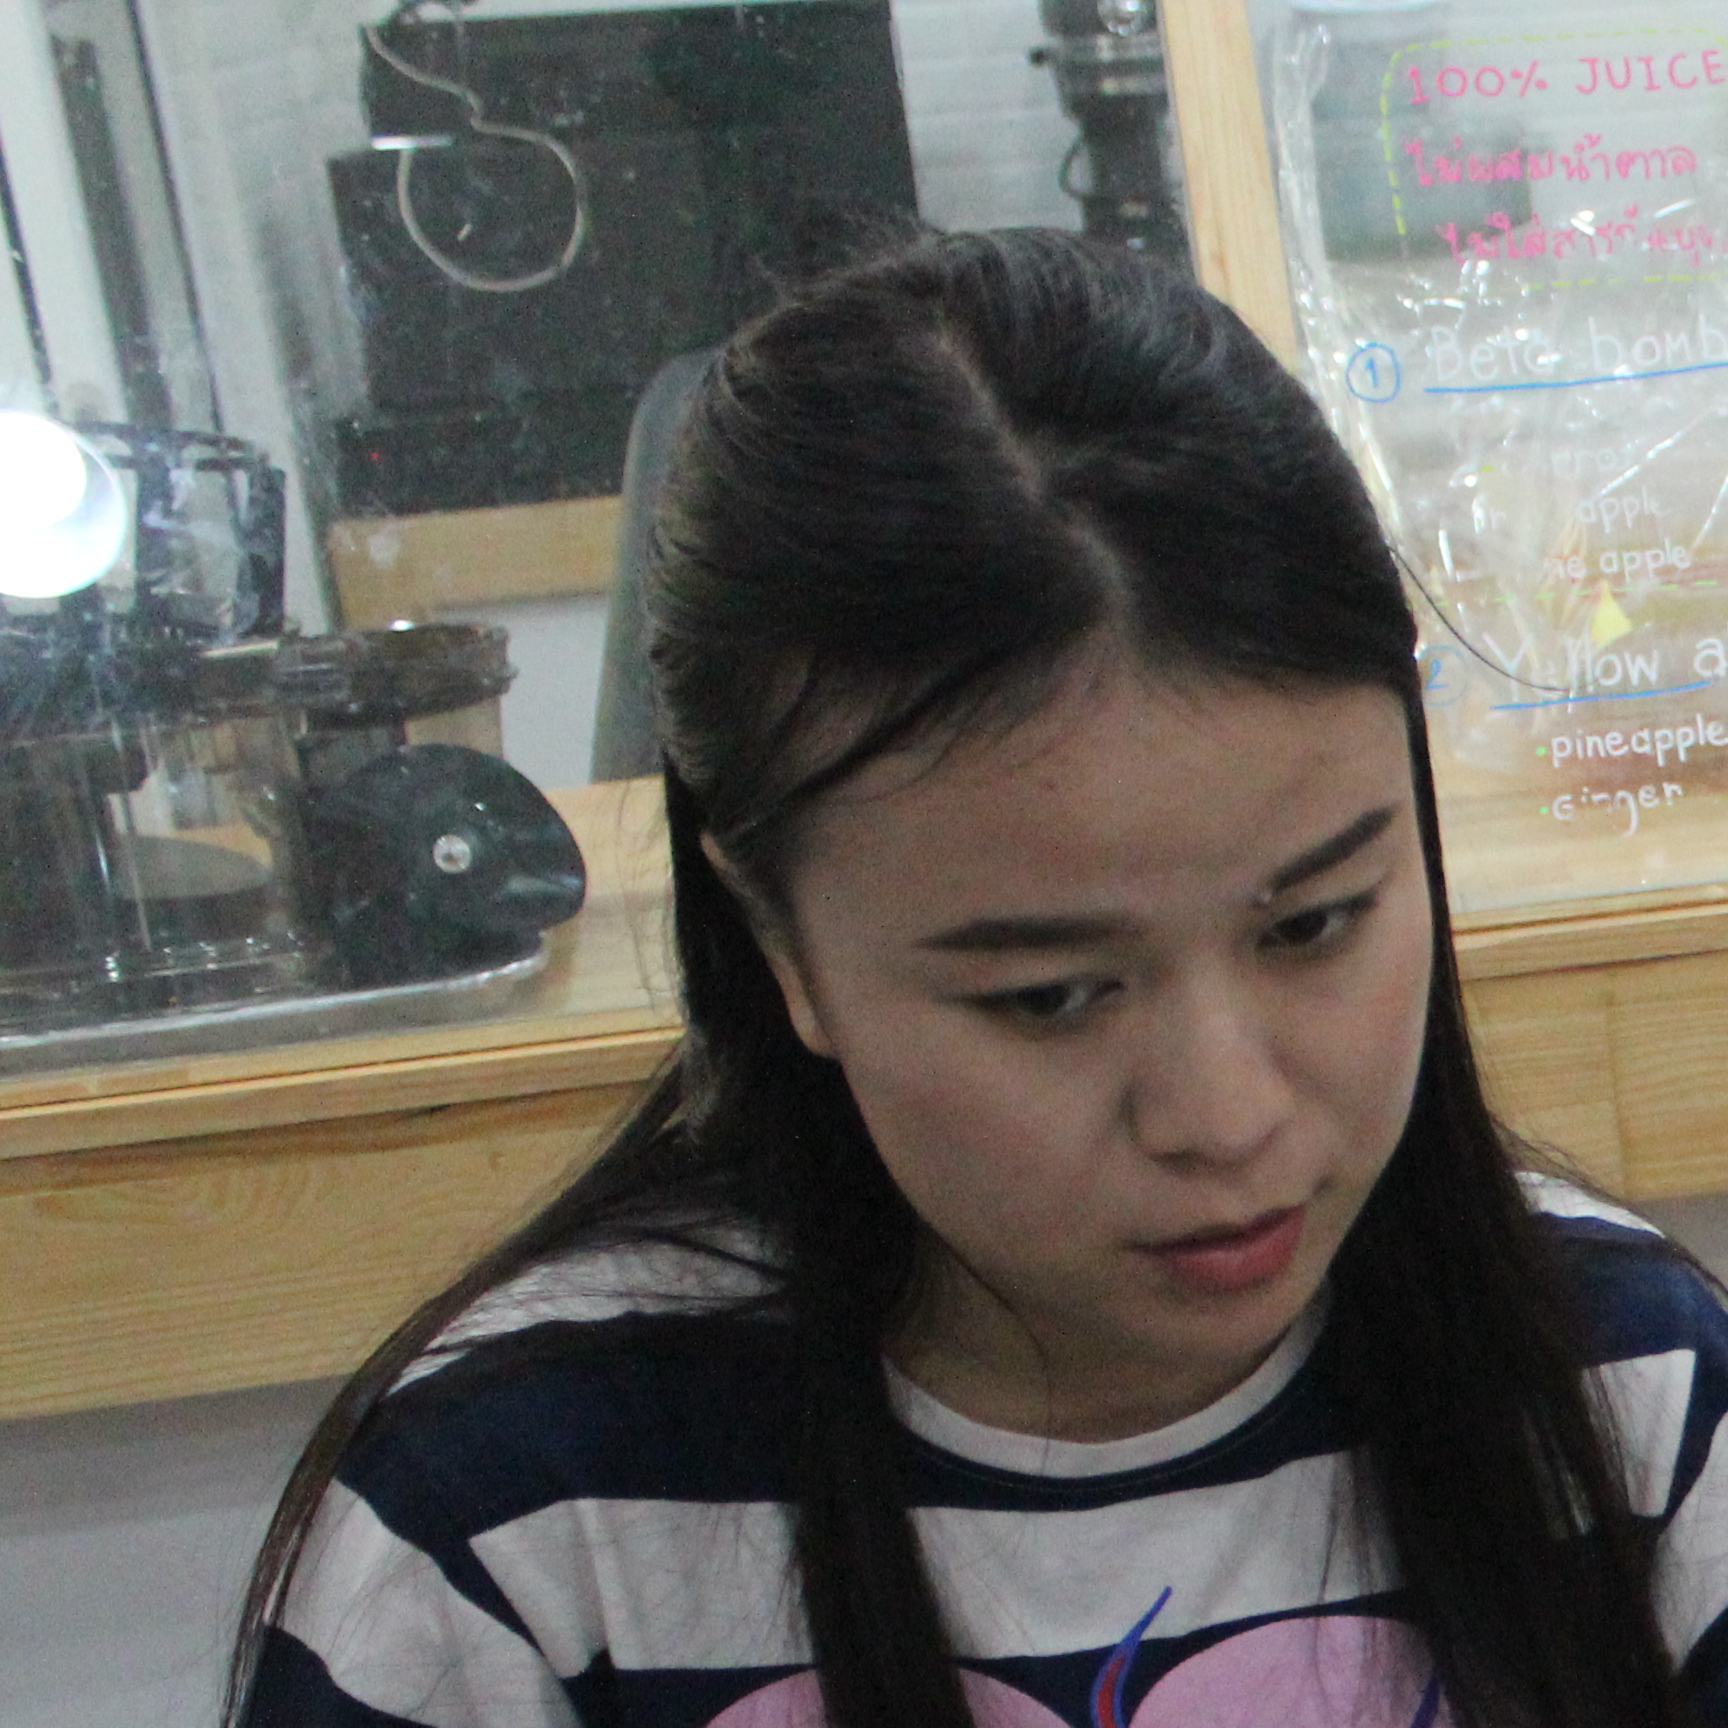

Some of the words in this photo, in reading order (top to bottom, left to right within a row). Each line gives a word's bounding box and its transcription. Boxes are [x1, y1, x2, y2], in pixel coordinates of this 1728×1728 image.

[1405, 58, 1548, 106] 100%
[1576, 50, 1728, 95] JUICE
[1430, 327, 1562, 382] Beta
[1576, 485, 1672, 534] apple
[1599, 536, 1692, 584] apple
